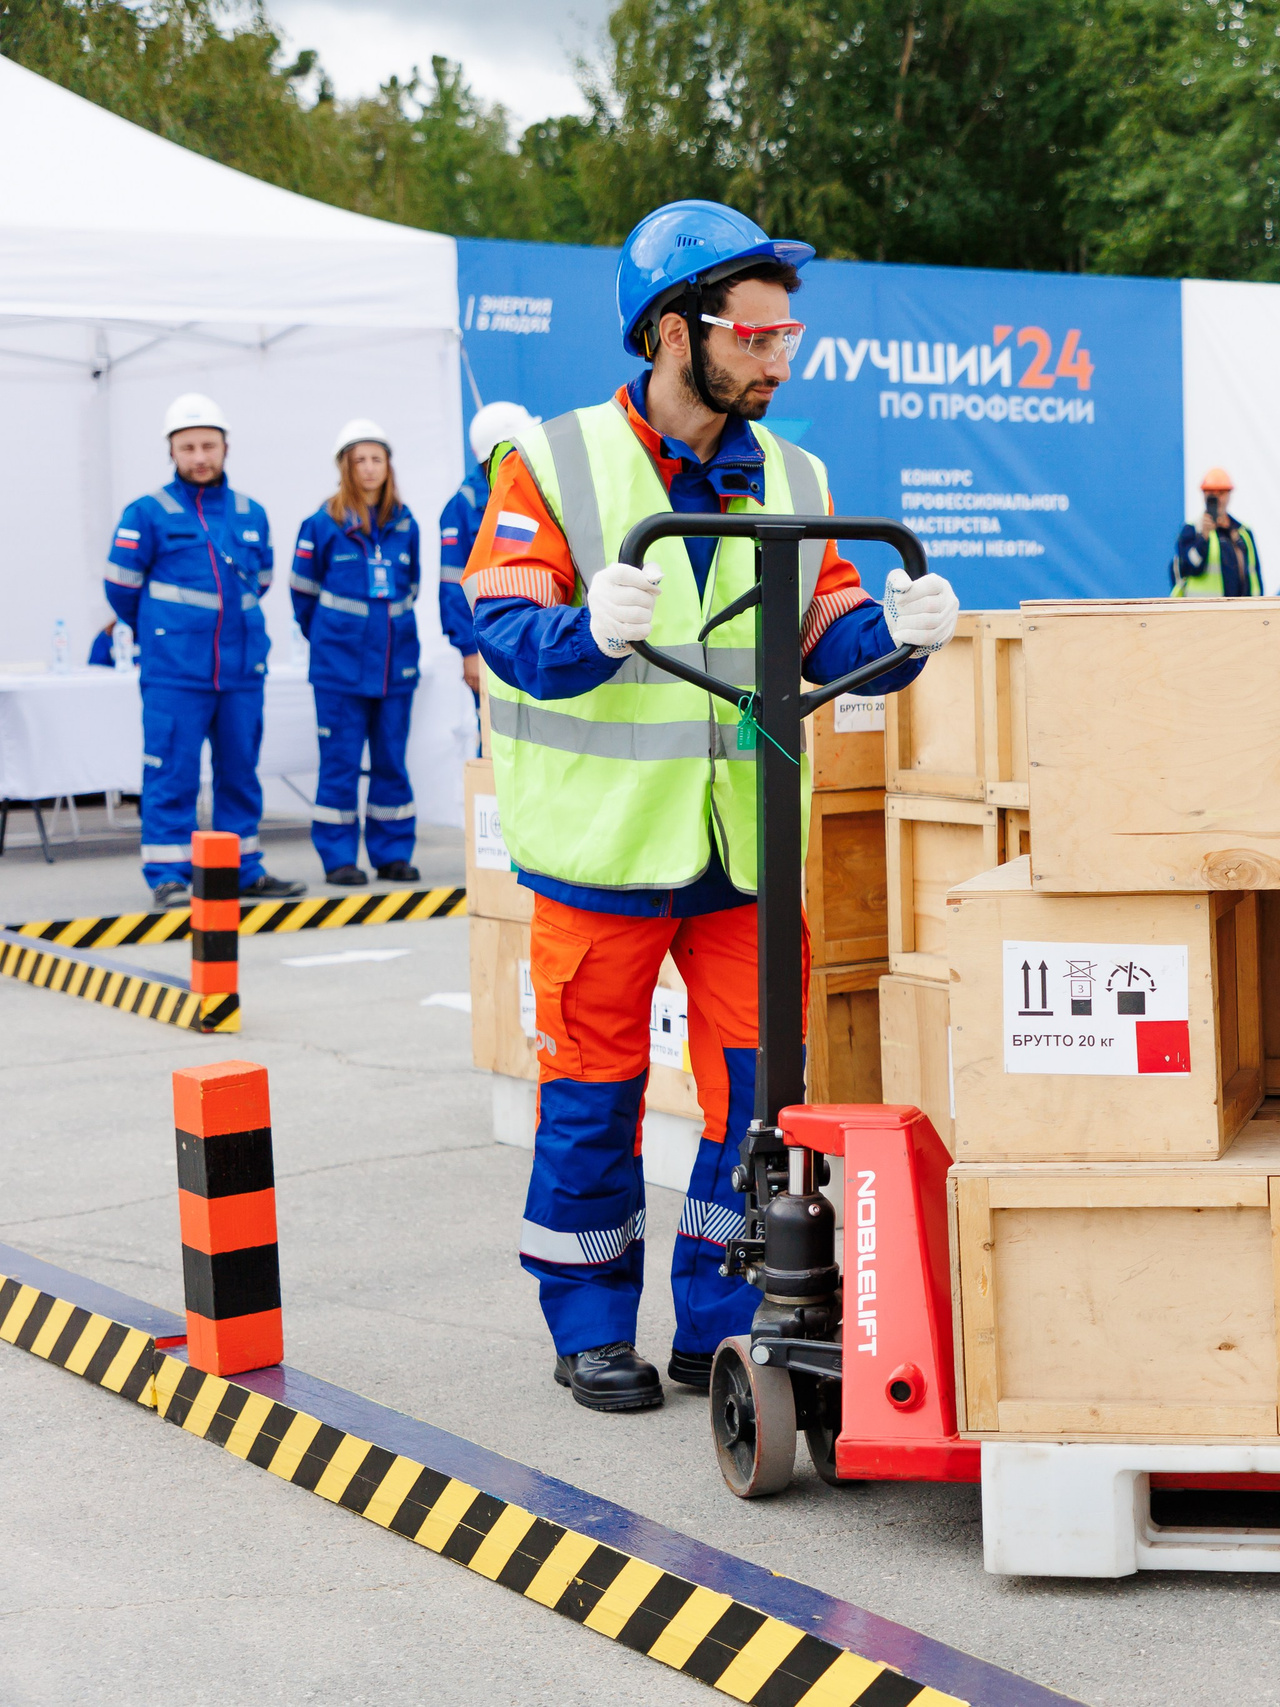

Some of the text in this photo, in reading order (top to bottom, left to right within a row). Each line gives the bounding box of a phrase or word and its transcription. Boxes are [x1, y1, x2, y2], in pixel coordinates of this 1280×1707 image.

[479, 294, 553, 316] ЭНЕРГИЯ
[476, 314, 552, 335] В ЛЮДЯХ
[879, 391, 1095, 424] ПО ПРОФЕССИИ
[901, 468, 974, 487] КОНКУРС
[901, 492, 1070, 512] ПРОФЕССИОНАЛЬНОГО
[839, 702, 873, 713] БРУТТО
[1012, 1034, 1115, 1047] БРУТТО 20 кг
[856, 1169, 877, 1357] NOBLELIFT
